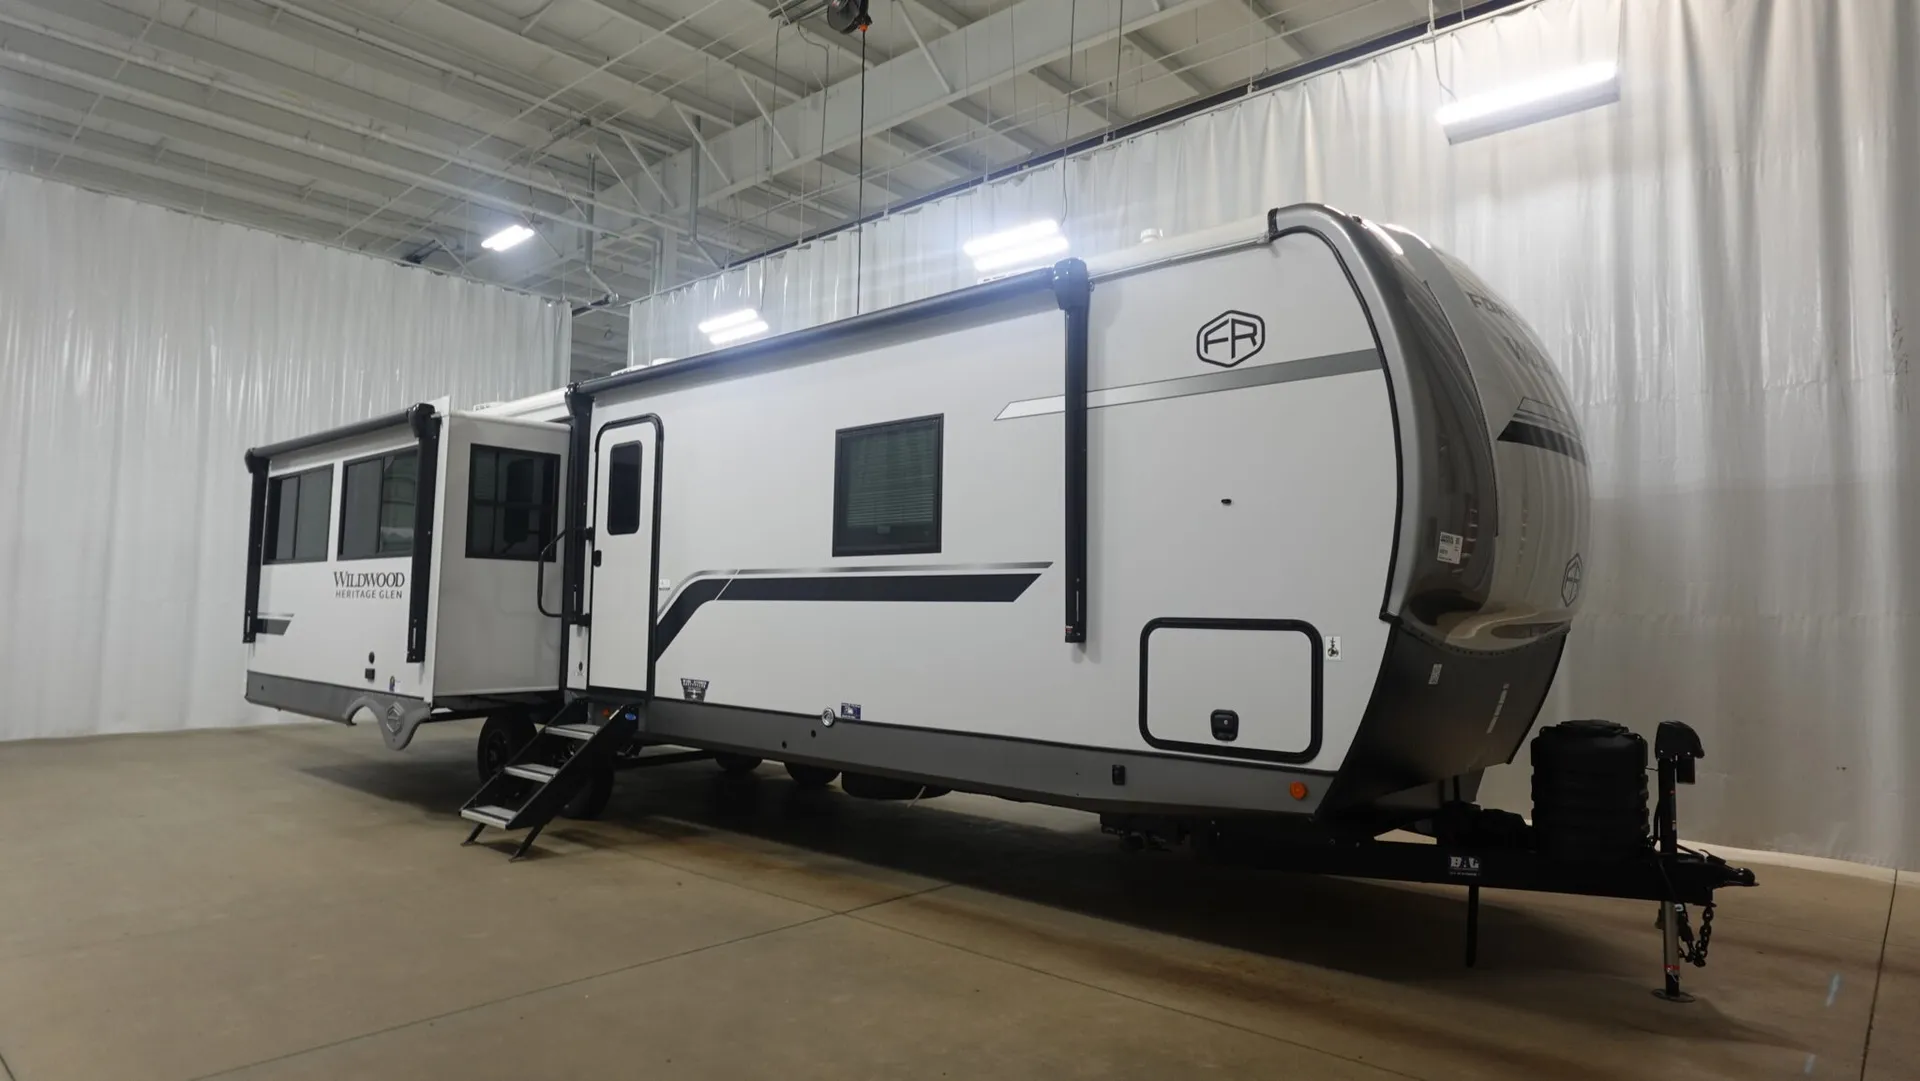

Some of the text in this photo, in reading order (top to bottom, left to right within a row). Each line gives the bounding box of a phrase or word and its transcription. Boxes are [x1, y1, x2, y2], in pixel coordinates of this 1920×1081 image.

[1203, 317, 1258, 360] FR
[333, 571, 405, 588] WILDWOOD
[335, 589, 402, 599] HERITAGE GLEN
